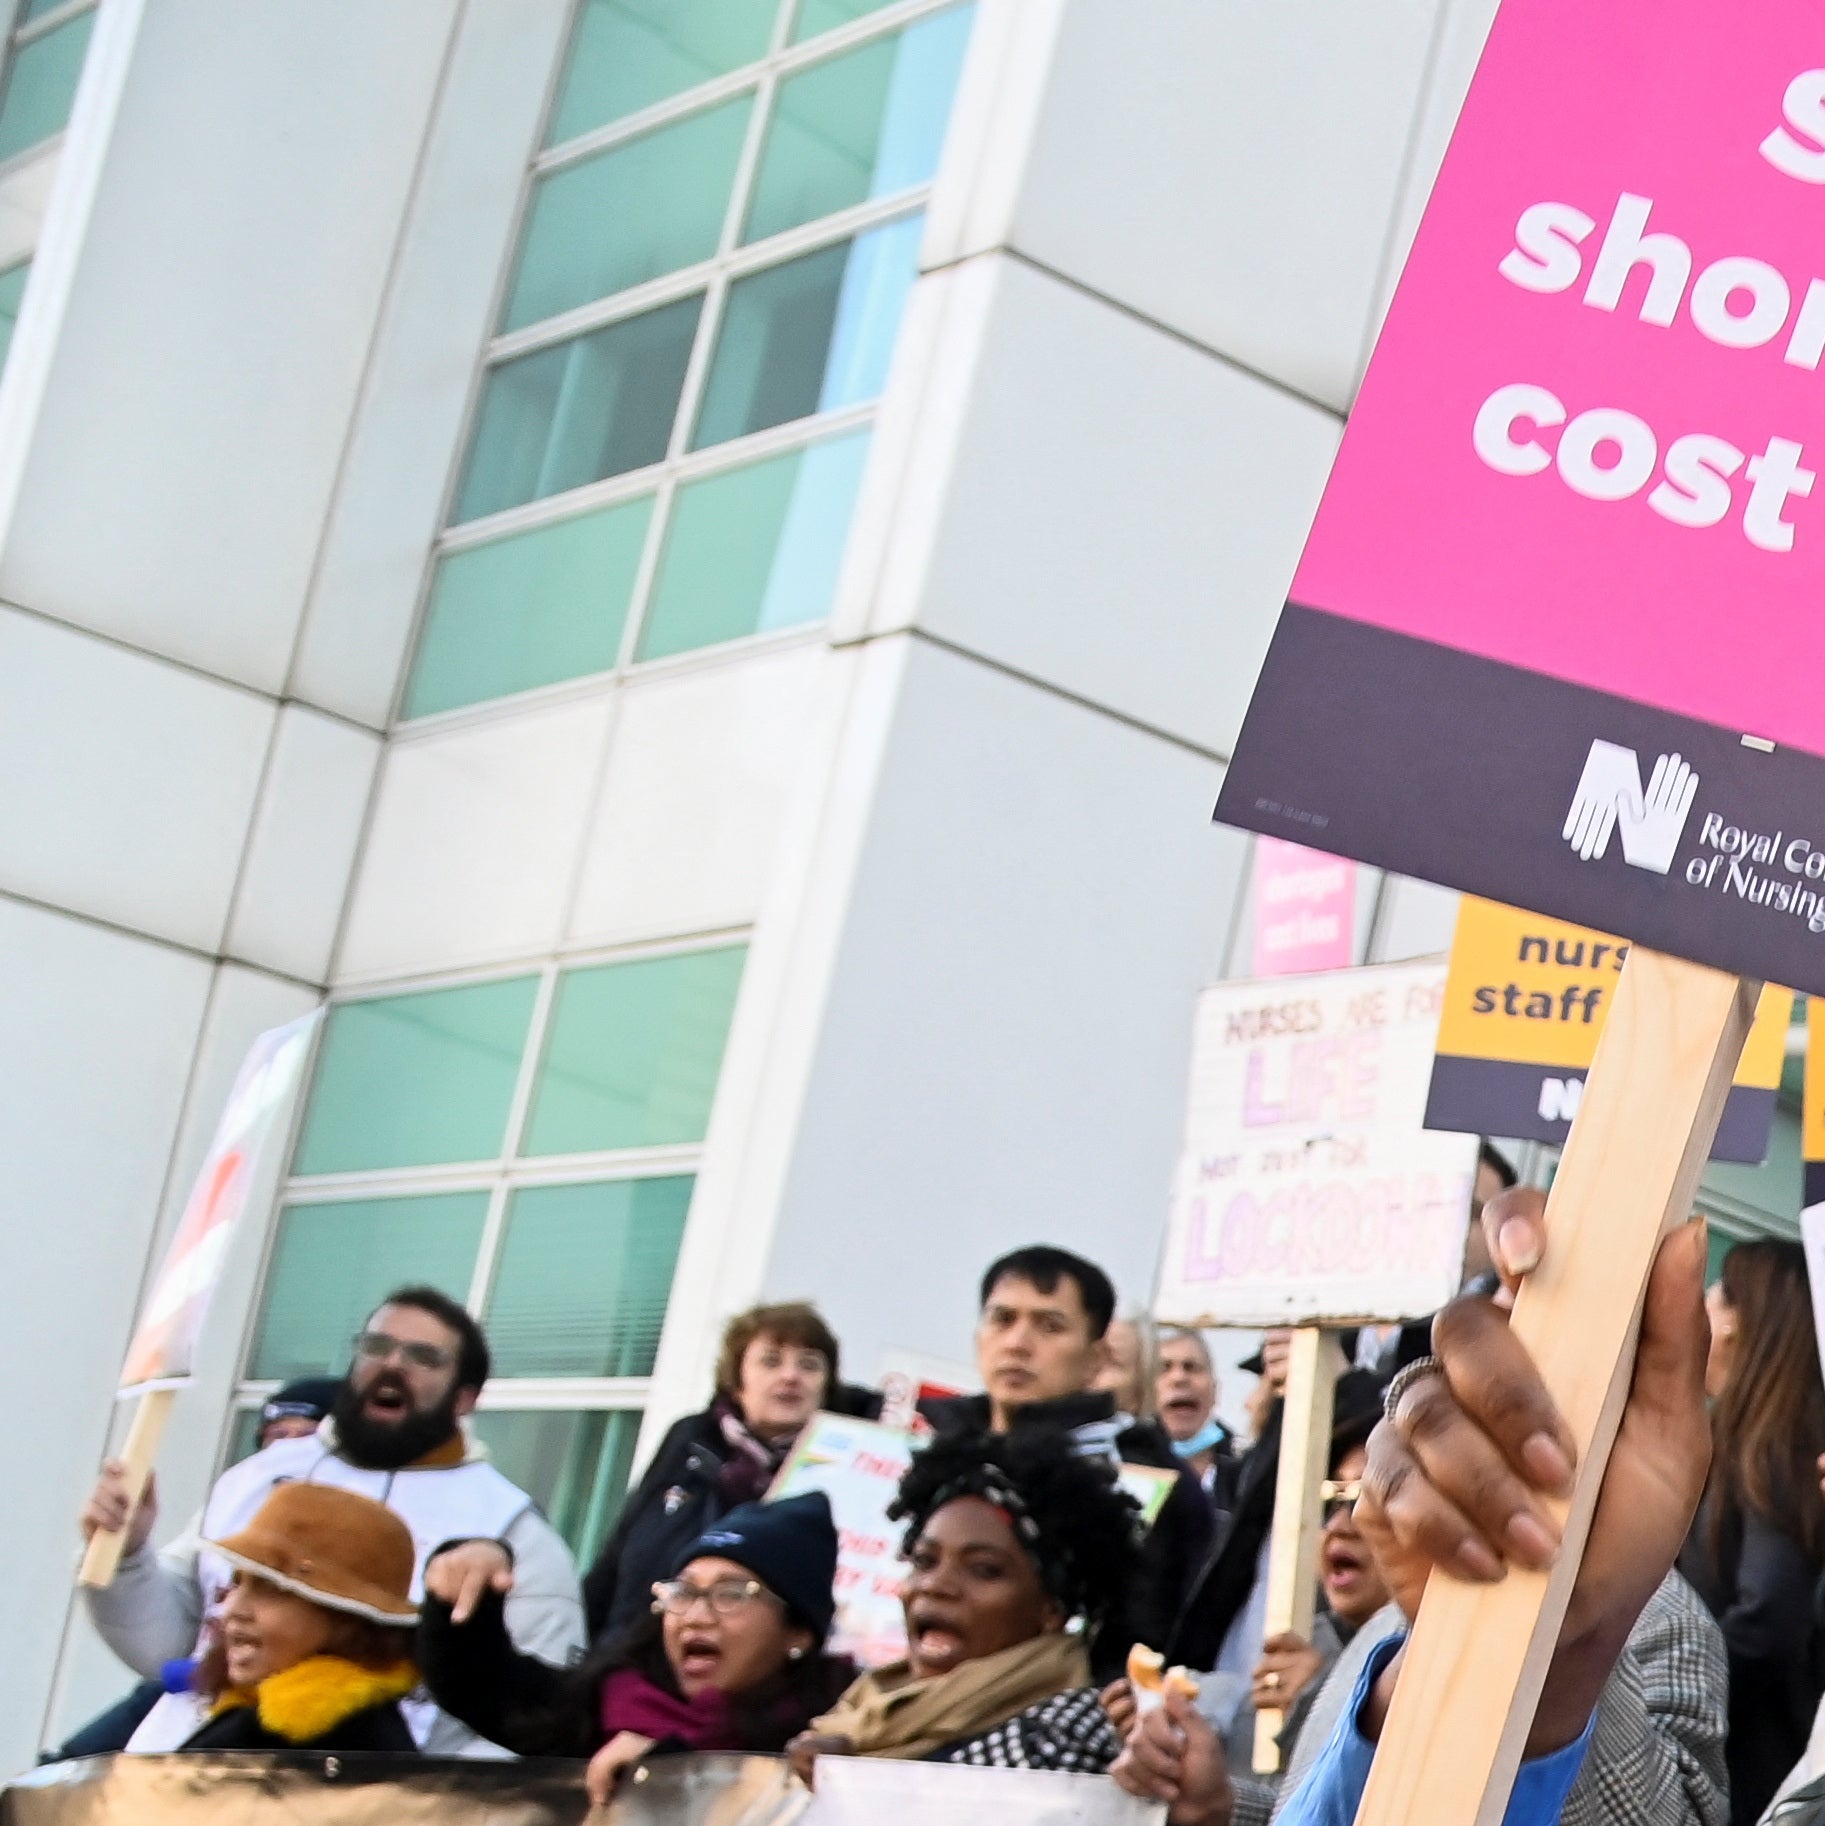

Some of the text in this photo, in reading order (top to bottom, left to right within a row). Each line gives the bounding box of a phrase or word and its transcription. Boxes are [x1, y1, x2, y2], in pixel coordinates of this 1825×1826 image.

[1472, 383, 1815, 550] cost
[1700, 812, 1782, 865] Royal
[1686, 854, 1724, 888] of
[1472, 983, 1603, 1024] staff
